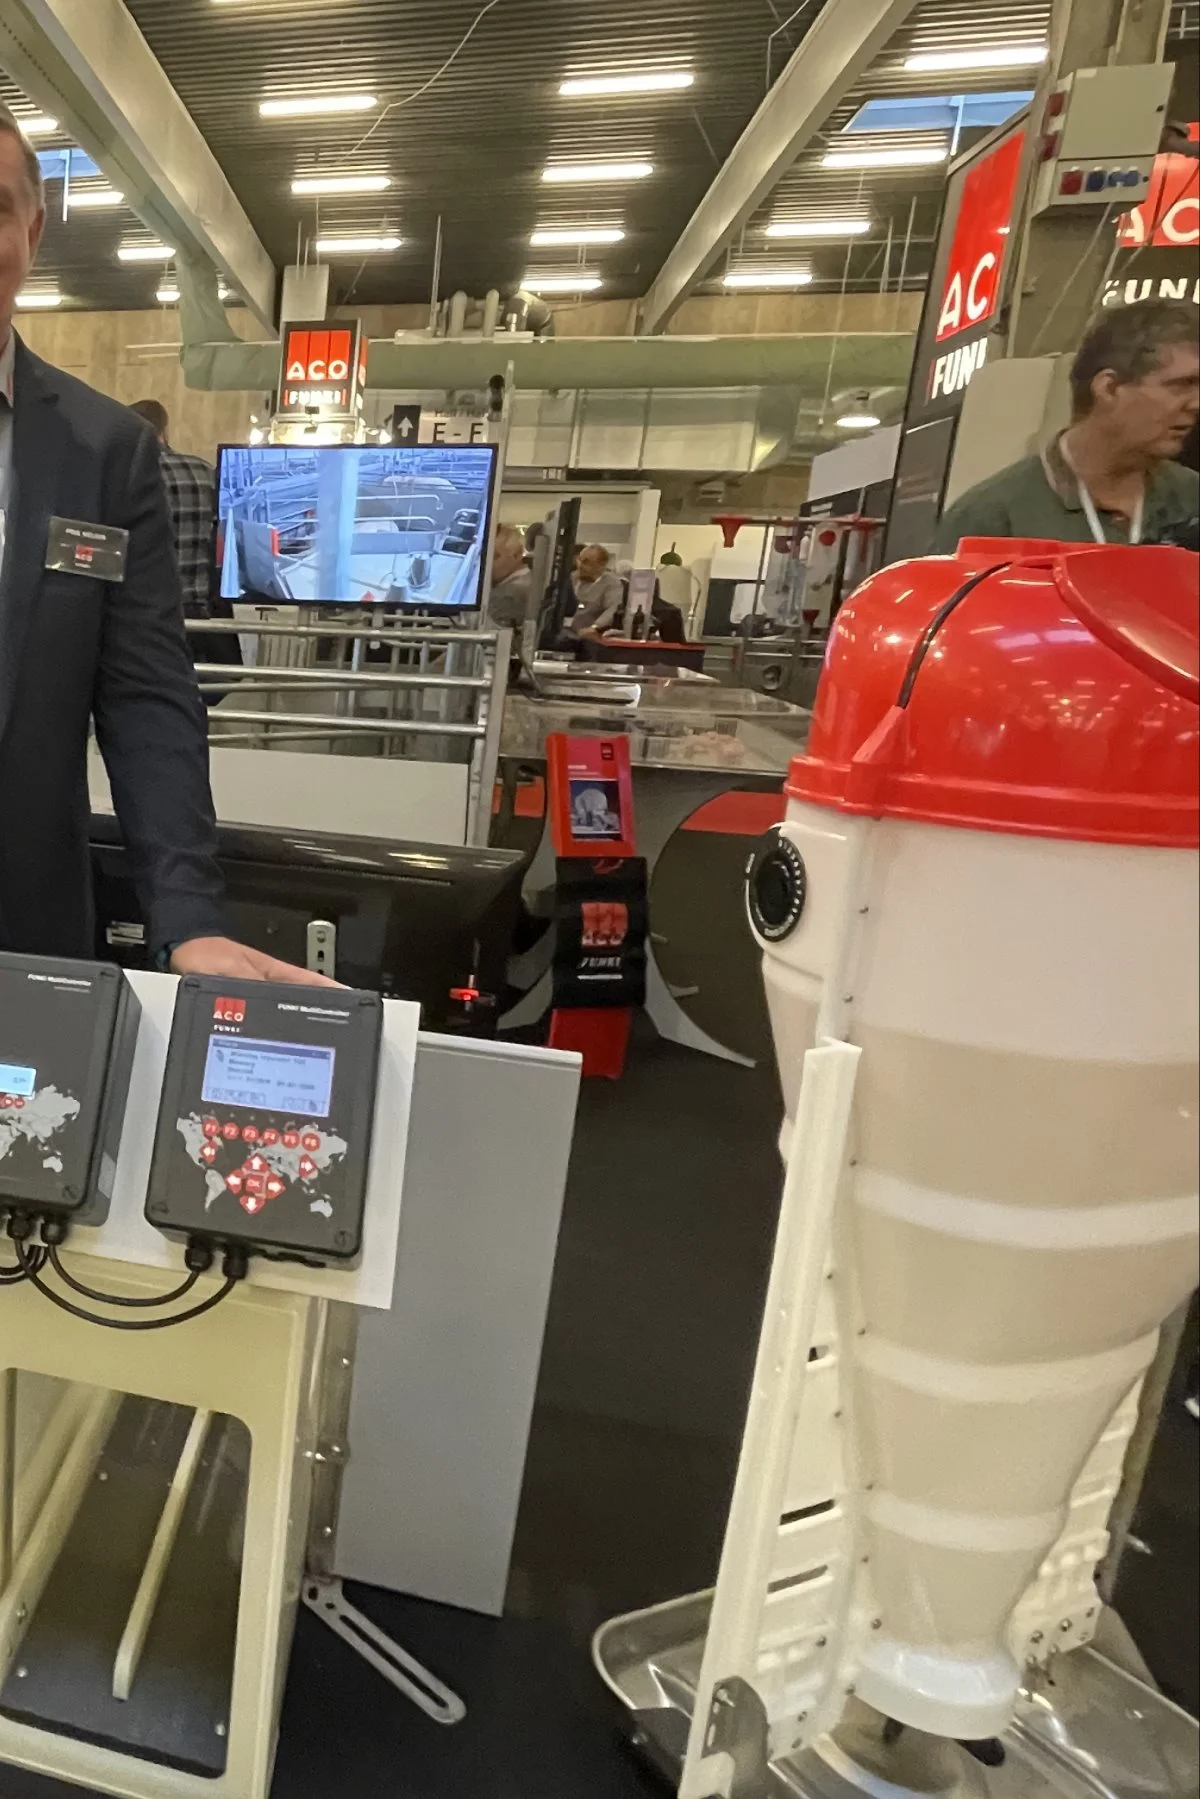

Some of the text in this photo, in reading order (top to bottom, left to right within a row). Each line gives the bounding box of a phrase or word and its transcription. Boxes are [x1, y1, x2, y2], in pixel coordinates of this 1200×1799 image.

[286, 360, 348, 380] ACO
[433, 422, 447, 443] E
[212, 1010, 245, 1023] ACO
